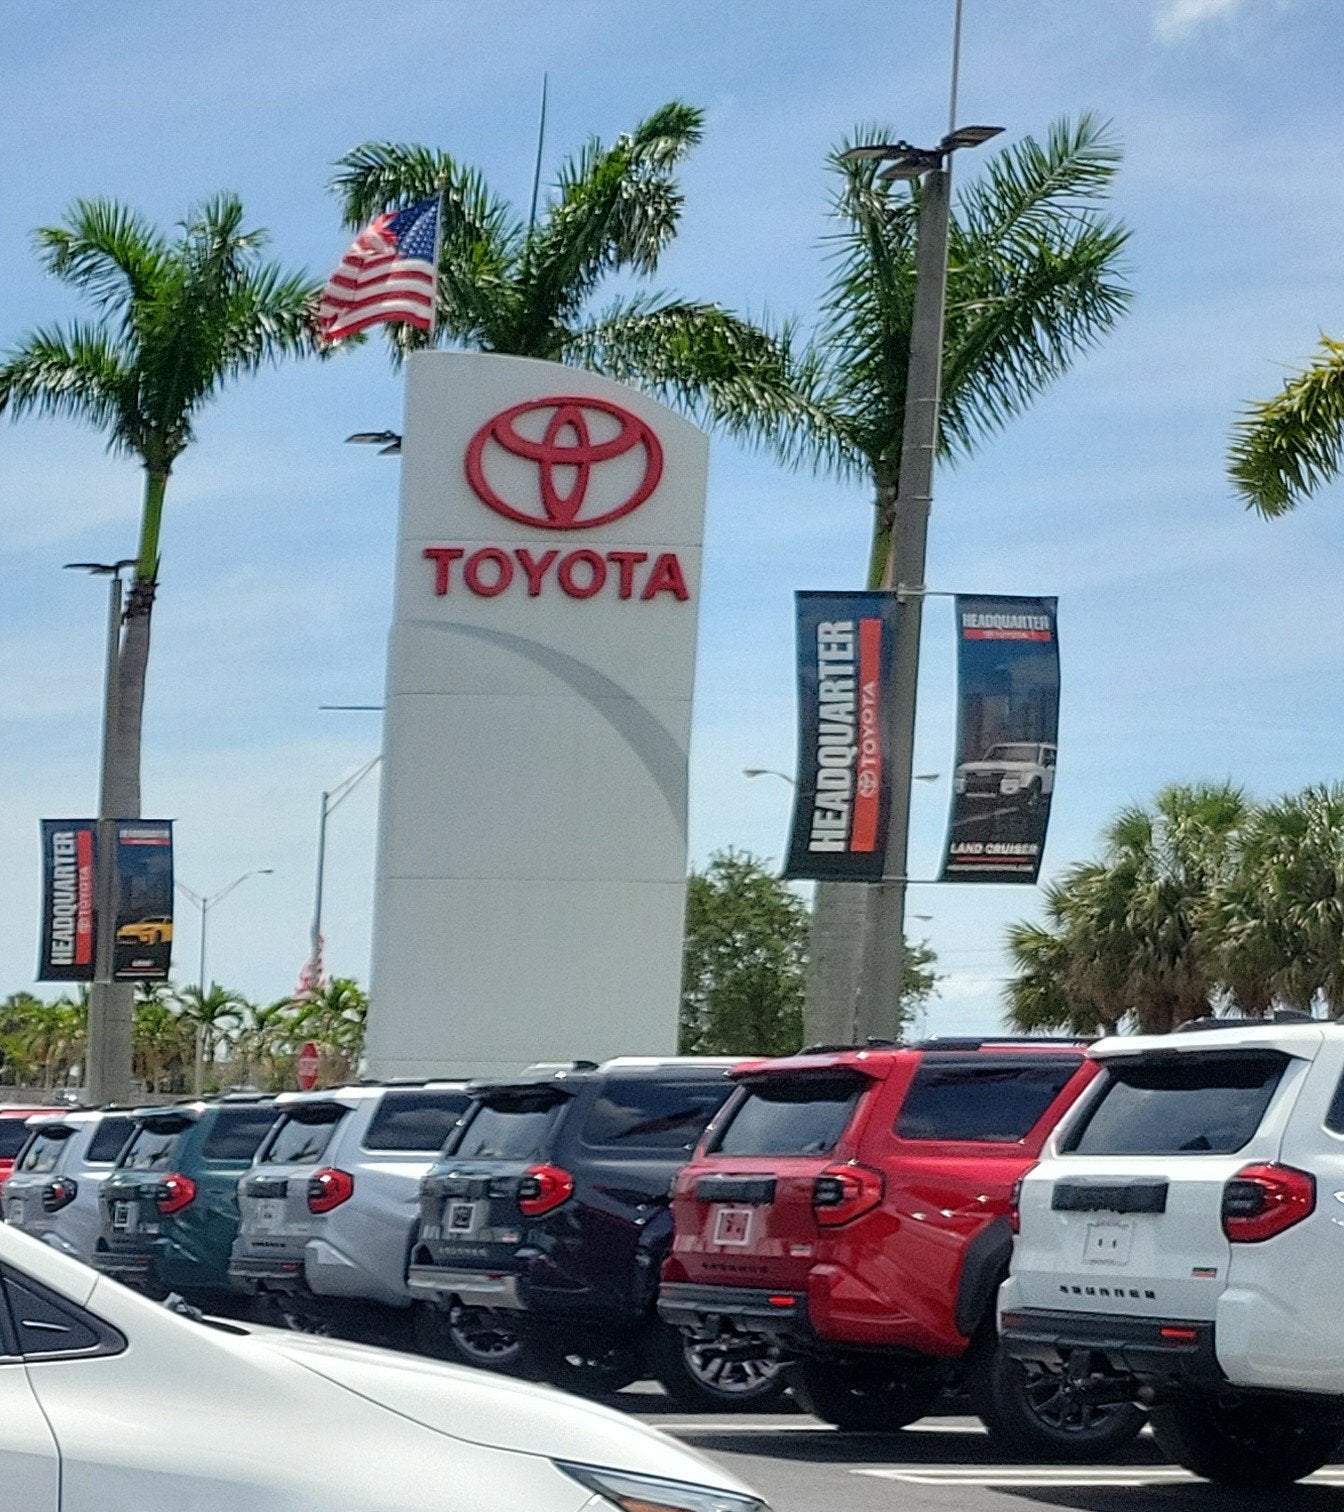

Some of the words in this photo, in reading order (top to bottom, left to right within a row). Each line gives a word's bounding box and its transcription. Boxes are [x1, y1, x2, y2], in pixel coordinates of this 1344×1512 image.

[423, 548, 690, 601] TOYOTA
[962, 613, 1050, 631] HEADQUARTER
[808, 620, 858, 853] HEADQUARTER
[862, 681, 877, 773] TOYOTA
[950, 842, 984, 854] LAND
[985, 842, 1039, 855] CRUISER
[50, 832, 78, 965] HEADQUARTER
[79, 866, 92, 918] TOYOTA
